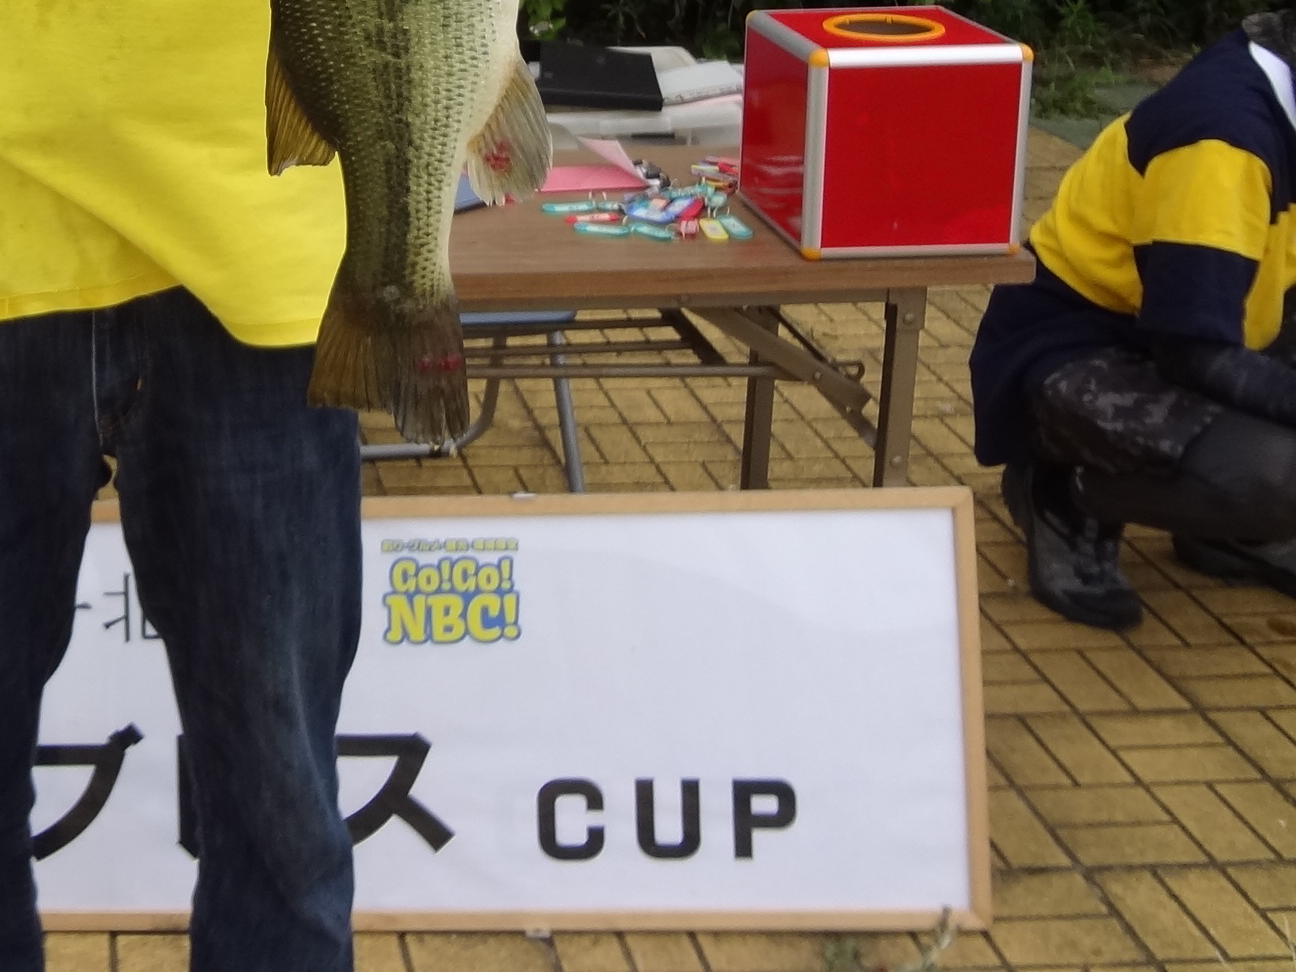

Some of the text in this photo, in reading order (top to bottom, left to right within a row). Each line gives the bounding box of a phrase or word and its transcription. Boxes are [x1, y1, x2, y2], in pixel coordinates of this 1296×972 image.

[391, 556, 513, 594] Go!Go!
[383, 591, 521, 644] NBC!
[536, 777, 798, 860] CUP
